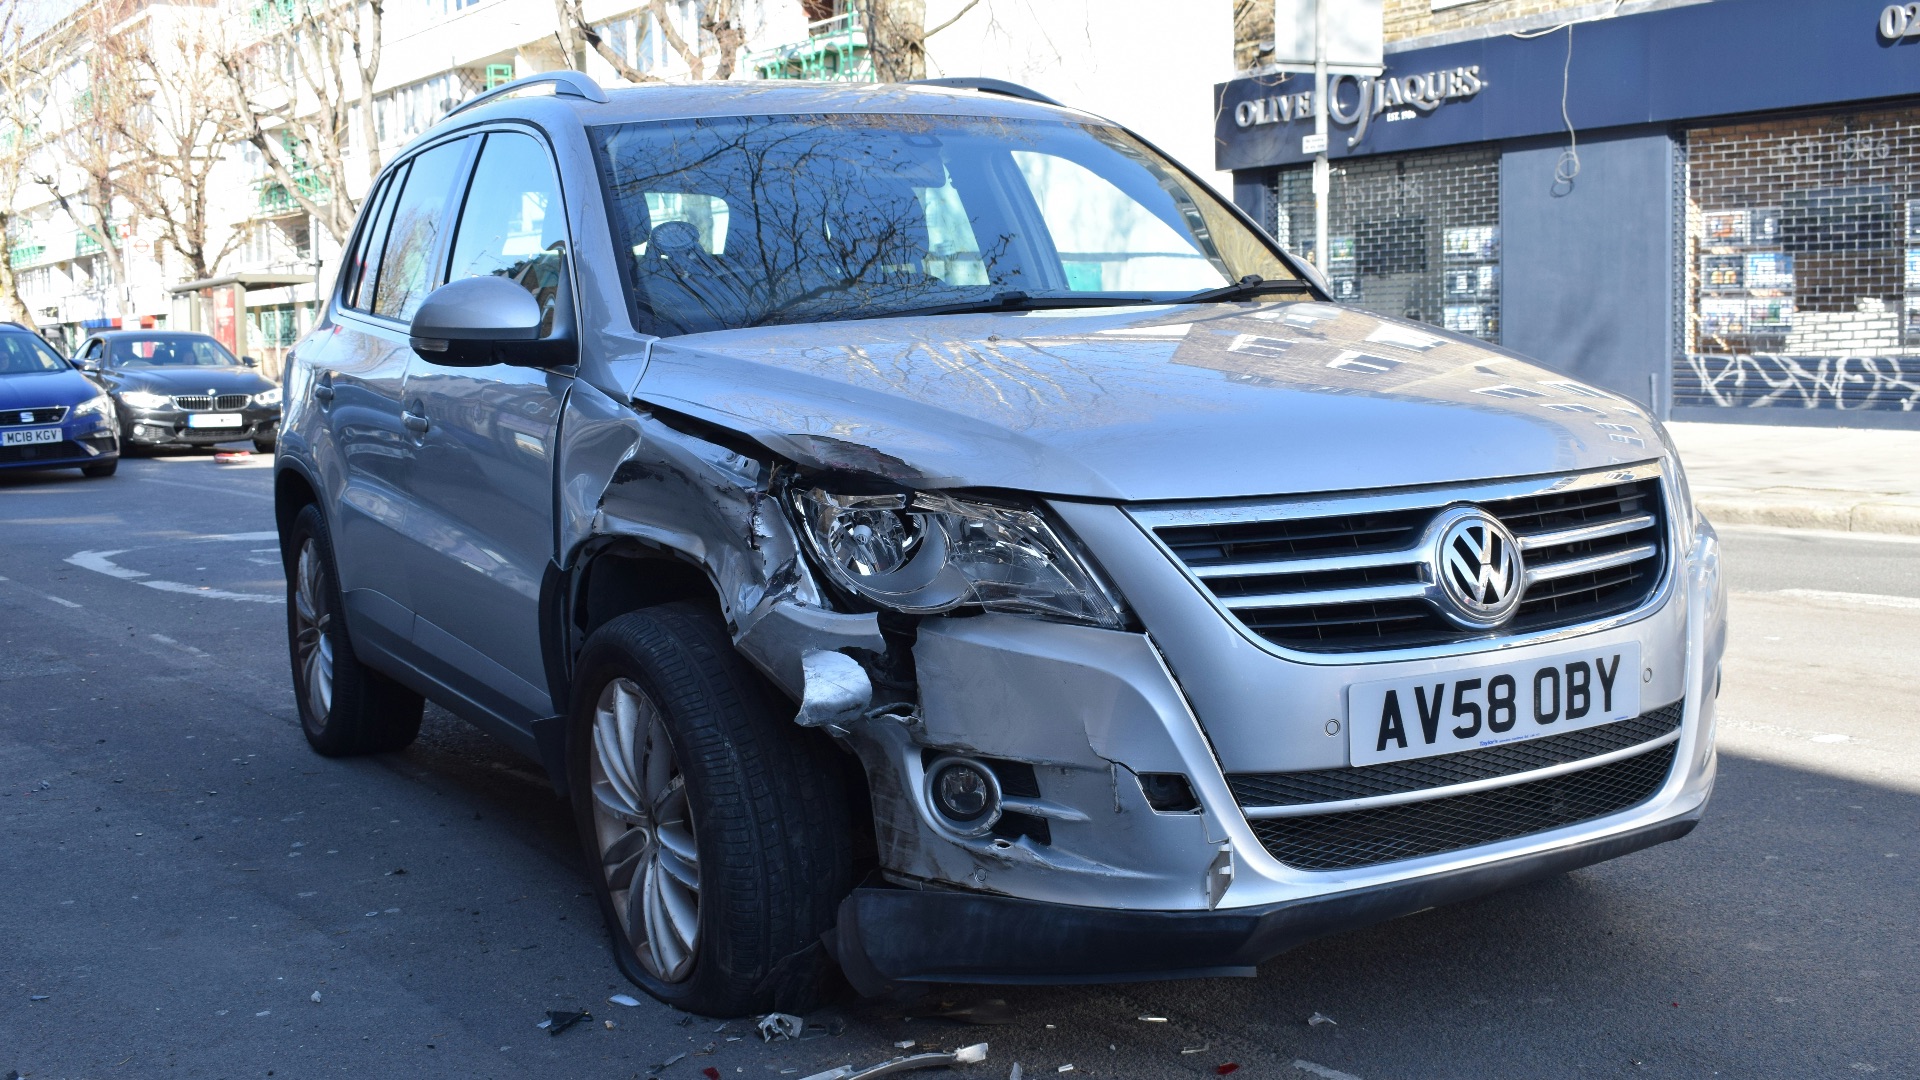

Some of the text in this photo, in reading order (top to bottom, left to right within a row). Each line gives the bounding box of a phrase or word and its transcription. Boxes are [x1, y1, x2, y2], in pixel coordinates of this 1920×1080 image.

[1373, 66, 1481, 110] JAQUES
[7, 430, 57, 443] MC18 KGV
[1376, 654, 1621, 751] AV58 OBY
